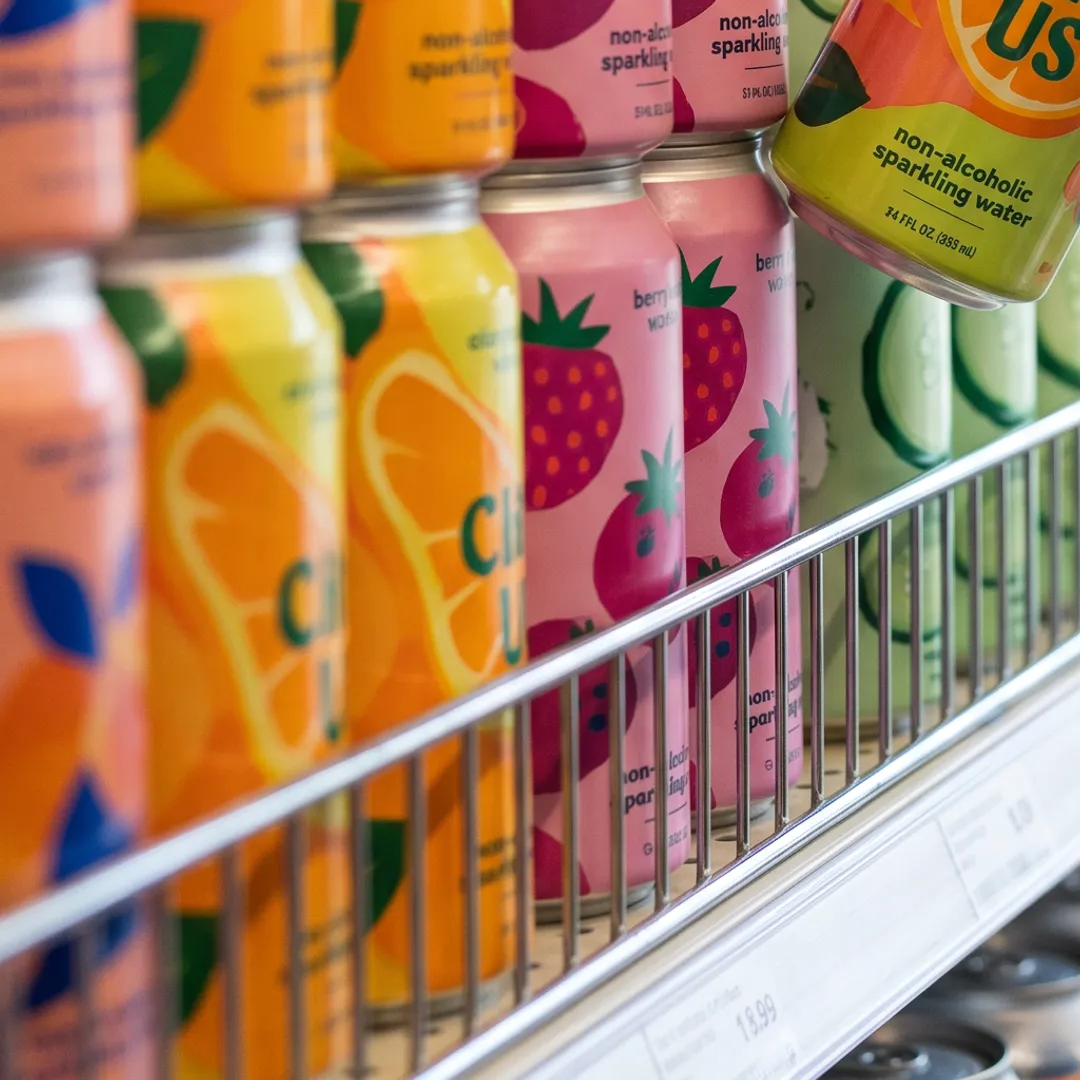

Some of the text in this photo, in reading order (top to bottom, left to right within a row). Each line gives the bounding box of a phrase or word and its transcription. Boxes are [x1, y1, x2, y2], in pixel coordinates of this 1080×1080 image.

[711, 31, 781, 60] sparkling
[873, 143, 1033, 228] sparkling water
[893, 126, 1034, 203] non-alcoholic
